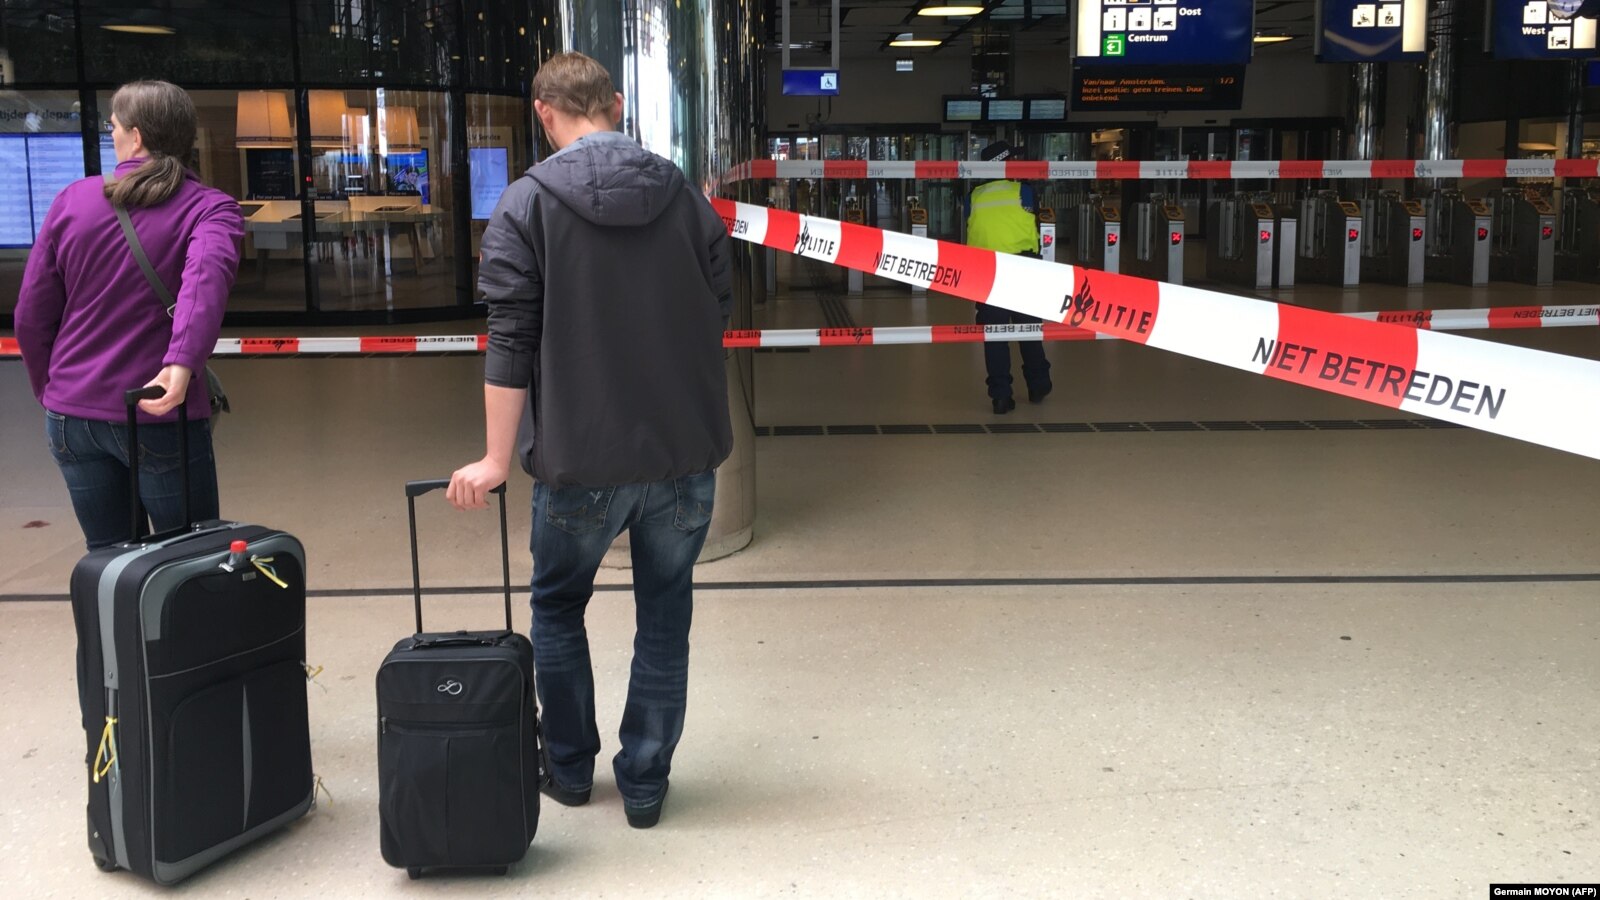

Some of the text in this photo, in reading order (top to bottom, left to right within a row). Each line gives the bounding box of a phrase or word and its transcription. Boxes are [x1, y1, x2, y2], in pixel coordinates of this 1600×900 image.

[1179, 7, 1201, 16] Oost
[1521, 26, 1546, 35] West
[1128, 33, 1169, 42] Centrum
[873, 251, 962, 289] NIET BETREDEN
[1513, 308, 1576, 318] BETREDEN
[737, 329, 761, 338] NIET
[953, 324, 1044, 335] NIET BETREDEN
[1251, 336, 1507, 420] NIET BETREDEN
